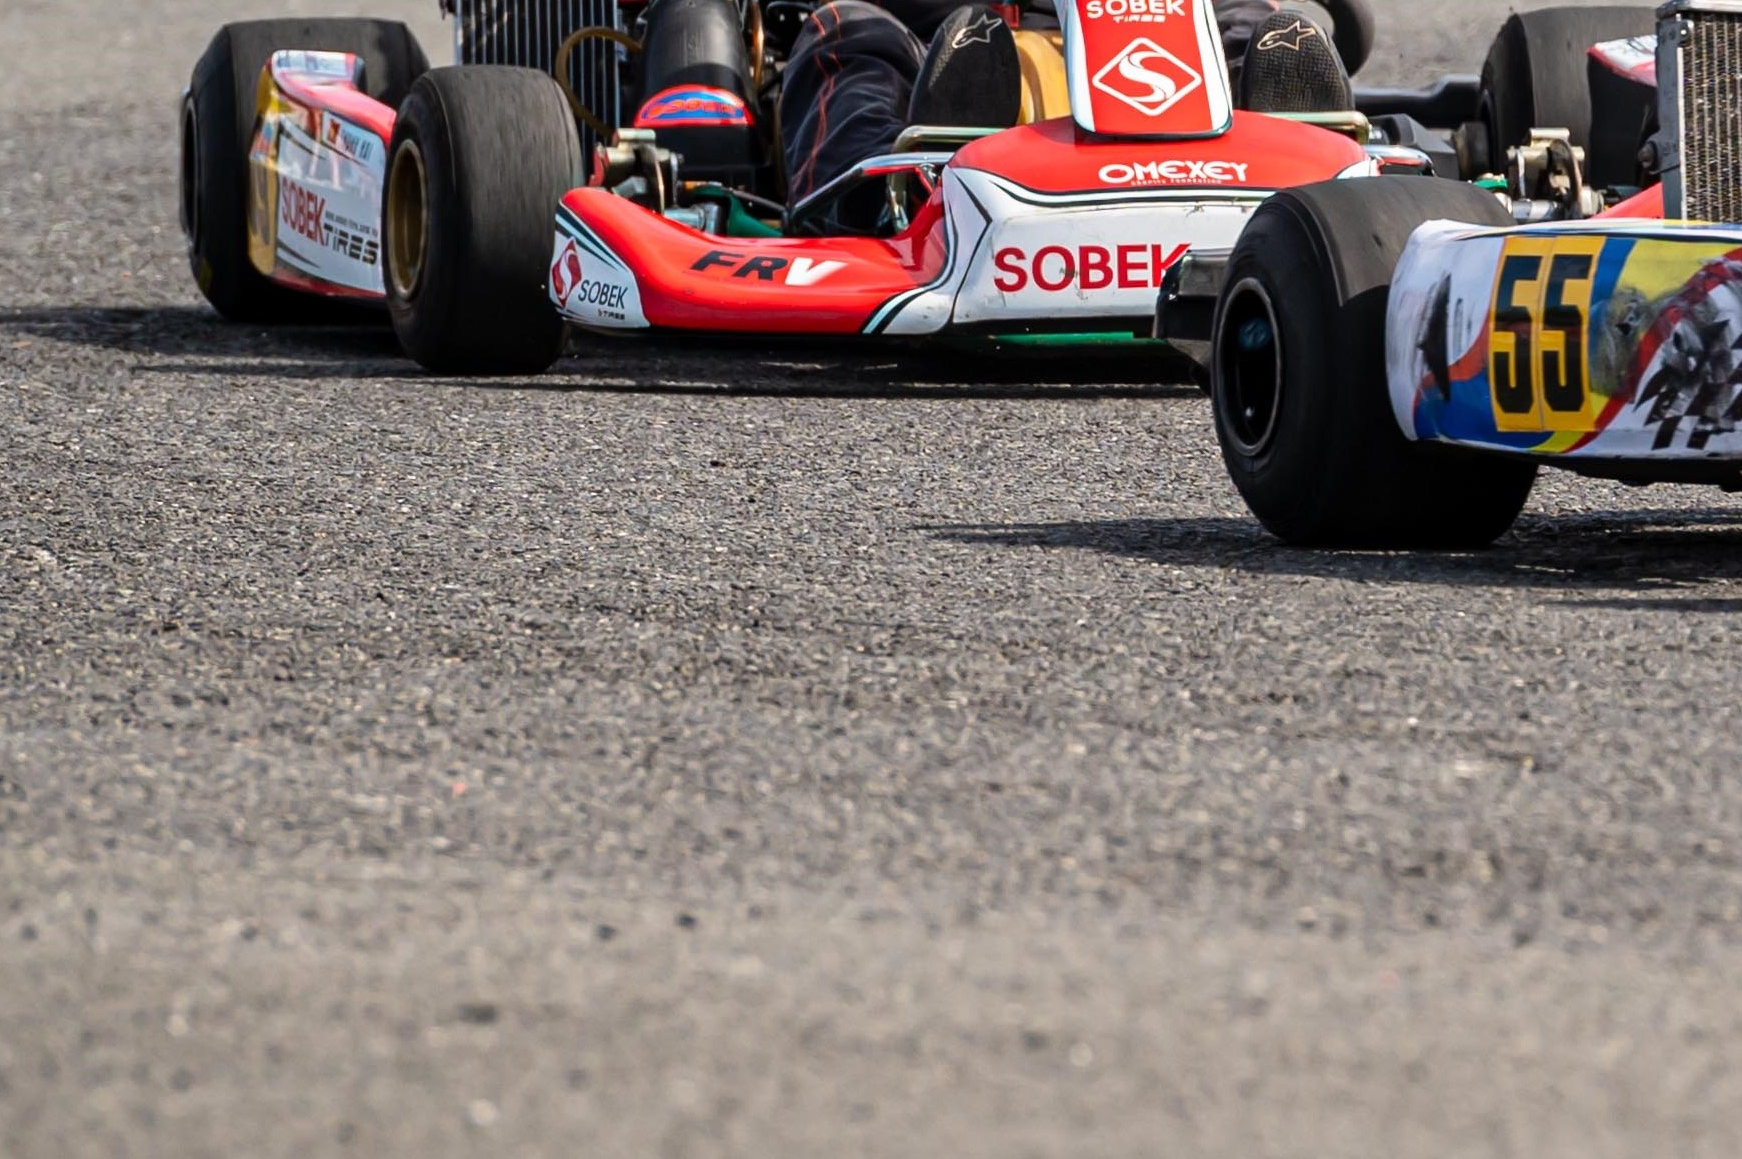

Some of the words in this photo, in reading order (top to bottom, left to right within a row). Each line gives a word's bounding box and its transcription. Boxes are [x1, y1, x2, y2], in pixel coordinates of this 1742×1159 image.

[1098, 160, 1248, 184] OMEXEY
[282, 176, 326, 246] SOBEK
[690, 250, 849, 286] FRV
[993, 243, 1192, 292] SOBEK
[578, 279, 628, 310] SOBEK
[1492, 254, 1594, 414] 55
